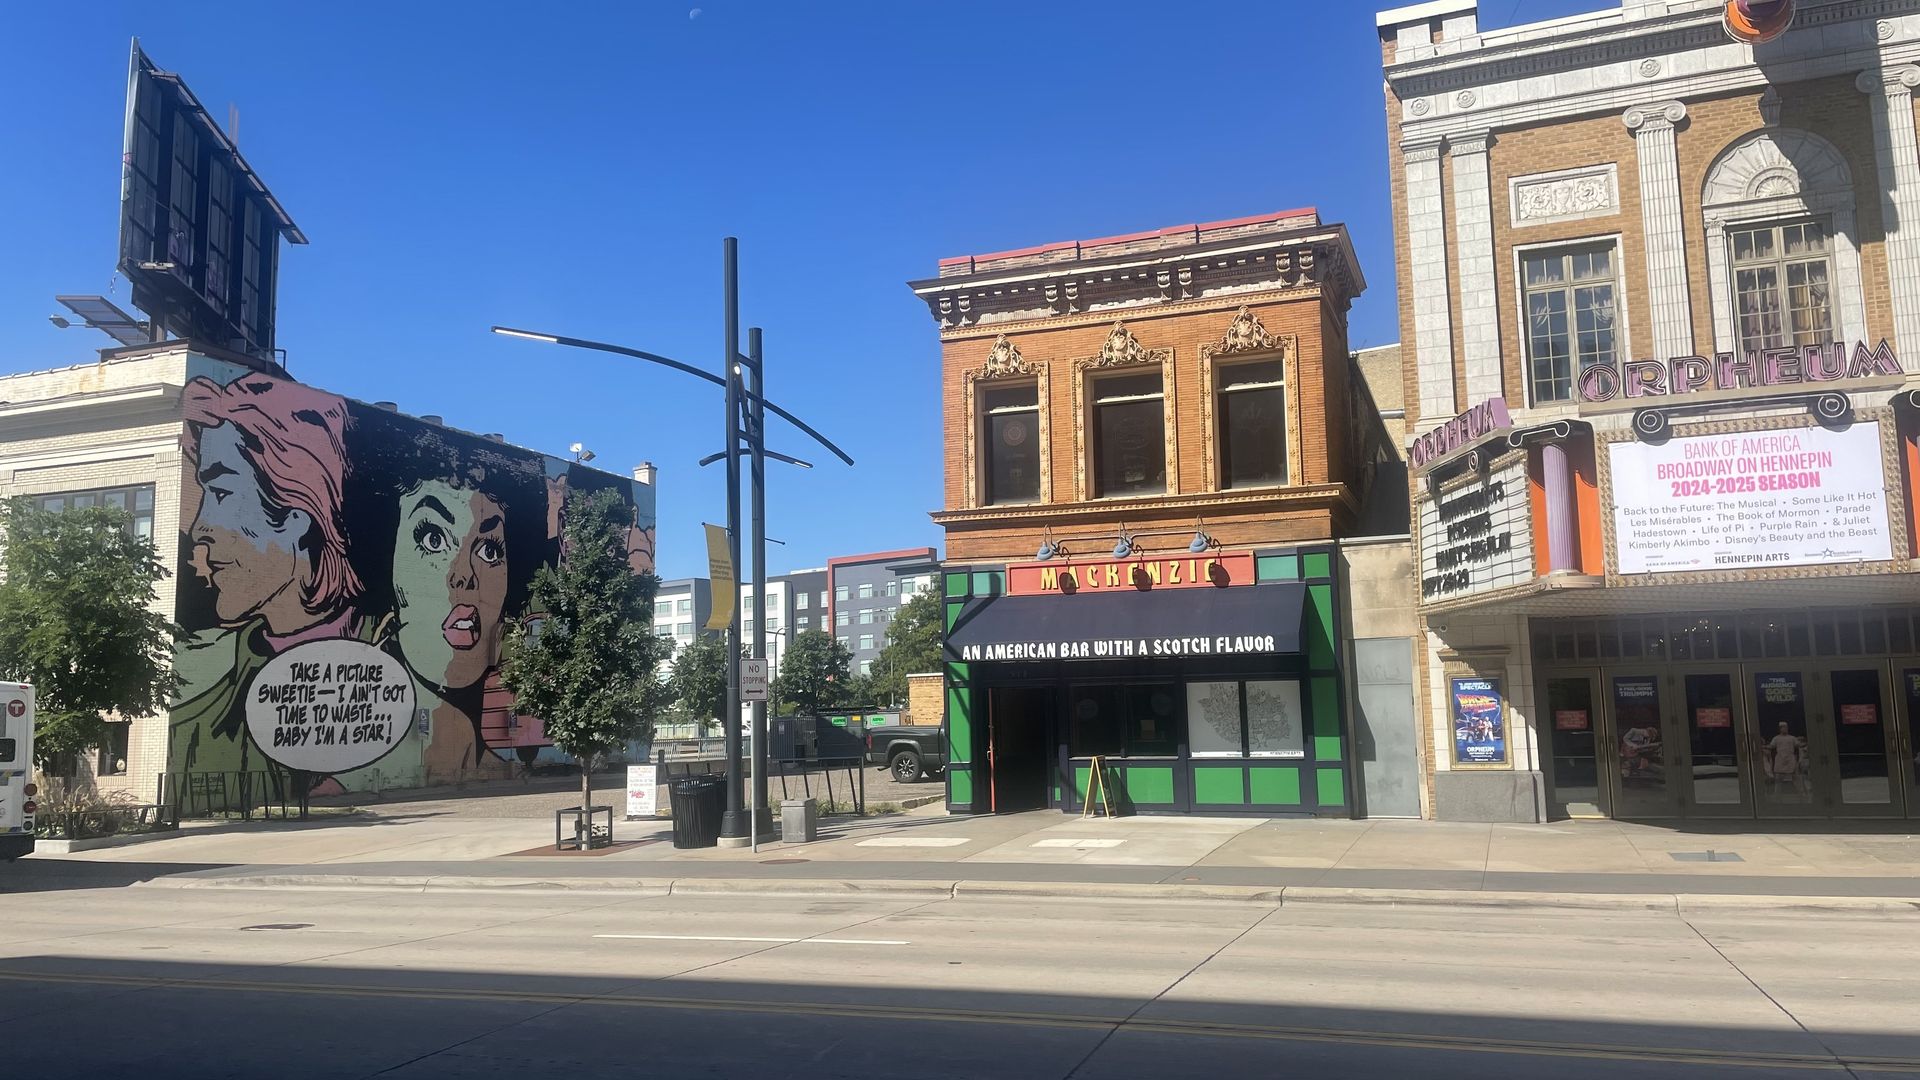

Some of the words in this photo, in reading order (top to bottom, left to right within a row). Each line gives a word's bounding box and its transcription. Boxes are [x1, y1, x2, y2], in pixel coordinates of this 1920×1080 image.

[1578, 337, 1904, 402] ORPHEUM
[1412, 397, 1510, 469] ORPHEUM
[1684, 442, 1718, 460] BANK
[1722, 439, 1738, 457] OF
[1742, 435, 1801, 455] AMERICA
[1657, 458, 1734, 480] BROADWAY
[1738, 457, 1758, 474] ON
[1760, 451, 1832, 473] HENNEPIN
[1672, 476, 1756, 498] 2024-2025
[1758, 471, 1821, 491] SEASON
[1624, 507, 1647, 516] Back
[1650, 506, 1659, 515] to
[1662, 505, 1678, 514] the
[1680, 504, 1715, 513] Future:
[1717, 501, 1735, 510] The
[1738, 498, 1776, 509] Musical
[1792, 497, 1820, 506] Some
[1824, 494, 1844, 503] Like
[1848, 493, 1855, 501] It
[1858, 492, 1876, 500] Hot
[1630, 518, 1646, 526] Les
[1650, 516, 1702, 526] Misérables
[1716, 512, 1734, 522] The
[1738, 511, 1763, 520] Book
[1766, 510, 1775, 519] of
[1778, 508, 1820, 518] Mormon
[1836, 504, 1871, 514] Parade
[1633, 528, 1687, 538] Hadestown
[1702, 525, 1719, 534] Life
[1722, 524, 1732, 533] of
[1736, 523, 1744, 532] Pi
[1760, 521, 1792, 532] Purple
[1795, 520, 1817, 529] Rain
[1833, 518, 1840, 526] &
[1842, 516, 1870, 526] Juliet
[1628, 539, 1670, 550] Kimberly
[1674, 538, 1710, 548] Akimbo
[1725, 534, 1766, 545] Disney's
[1770, 533, 1804, 543] Beauty
[1807, 530, 1826, 540] and
[1828, 529, 1845, 538] the
[1848, 528, 1878, 537] Beast
[1714, 554, 1763, 564] HENNEPIN
[1765, 552, 1790, 562] ARTS
[962, 645, 980, 660] AN
[985, 642, 1056, 660] AMERICAN
[1060, 641, 1090, 658] BAR
[1094, 640, 1133, 656] WITH
[1138, 640, 1148, 656] A
[1153, 637, 1210, 654] SCOTCH
[290, 662, 320, 682] TAKE
[322, 663, 332, 683] A
[336, 663, 383, 682] PICTURE
[743, 676, 766, 684] STOPPING
[748, 665, 760, 673] NO
[338, 684, 346, 703] I
[349, 684, 381, 704] AIN'T
[382, 684, 406, 703] GOT
[276, 704, 308, 724] TIME
[312, 704, 328, 724] TO
[332, 703, 392, 724] WASTE...
[274, 726, 312, 748] BABY
[314, 725, 334, 745] I'M
[338, 725, 348, 745] A
[353, 722, 392, 744] STAR!
